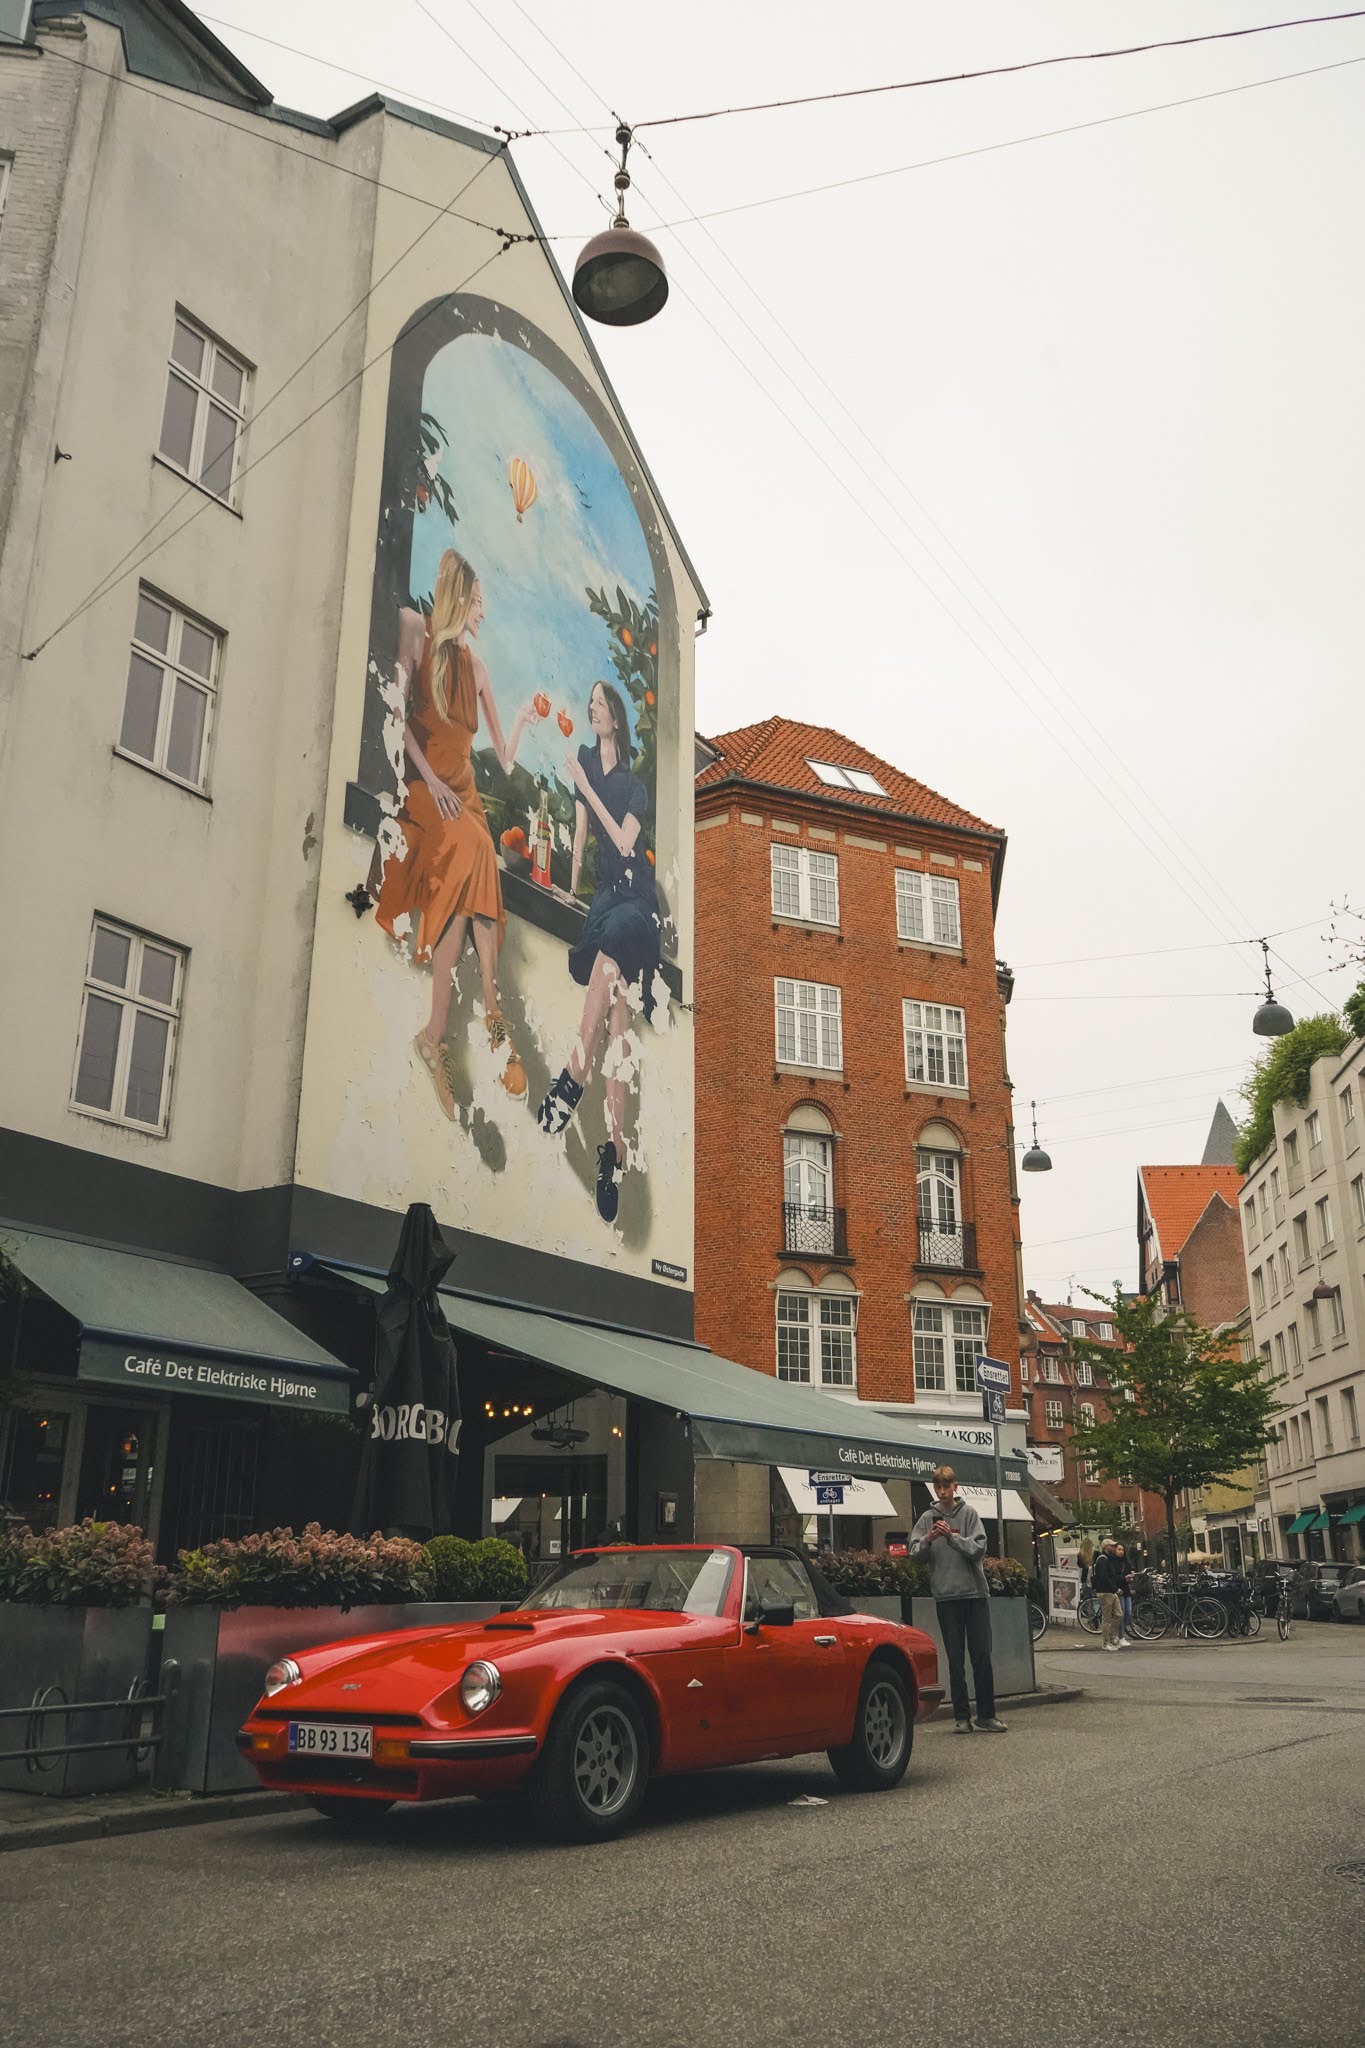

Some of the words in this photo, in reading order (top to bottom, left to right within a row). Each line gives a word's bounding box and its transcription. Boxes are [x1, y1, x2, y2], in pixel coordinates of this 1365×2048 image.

[125, 1355, 162, 1376] Café
[165, 1361, 194, 1380] Det
[197, 1366, 267, 1391] Elektriske
[271, 1377, 317, 1398] Hjørne
[983, 1366, 1008, 1383] Ensrettet
[839, 1447, 857, 1463] Café
[859, 1450, 873, 1465] Det
[874, 1452, 911, 1469] Elektriske
[911, 1456, 937, 1474] Hjørne
[817, 1473, 850, 1481] Ensrette
[298, 1728, 316, 1750] BB
[320, 1729, 337, 1752] 93
[342, 1731, 369, 1754] 134
